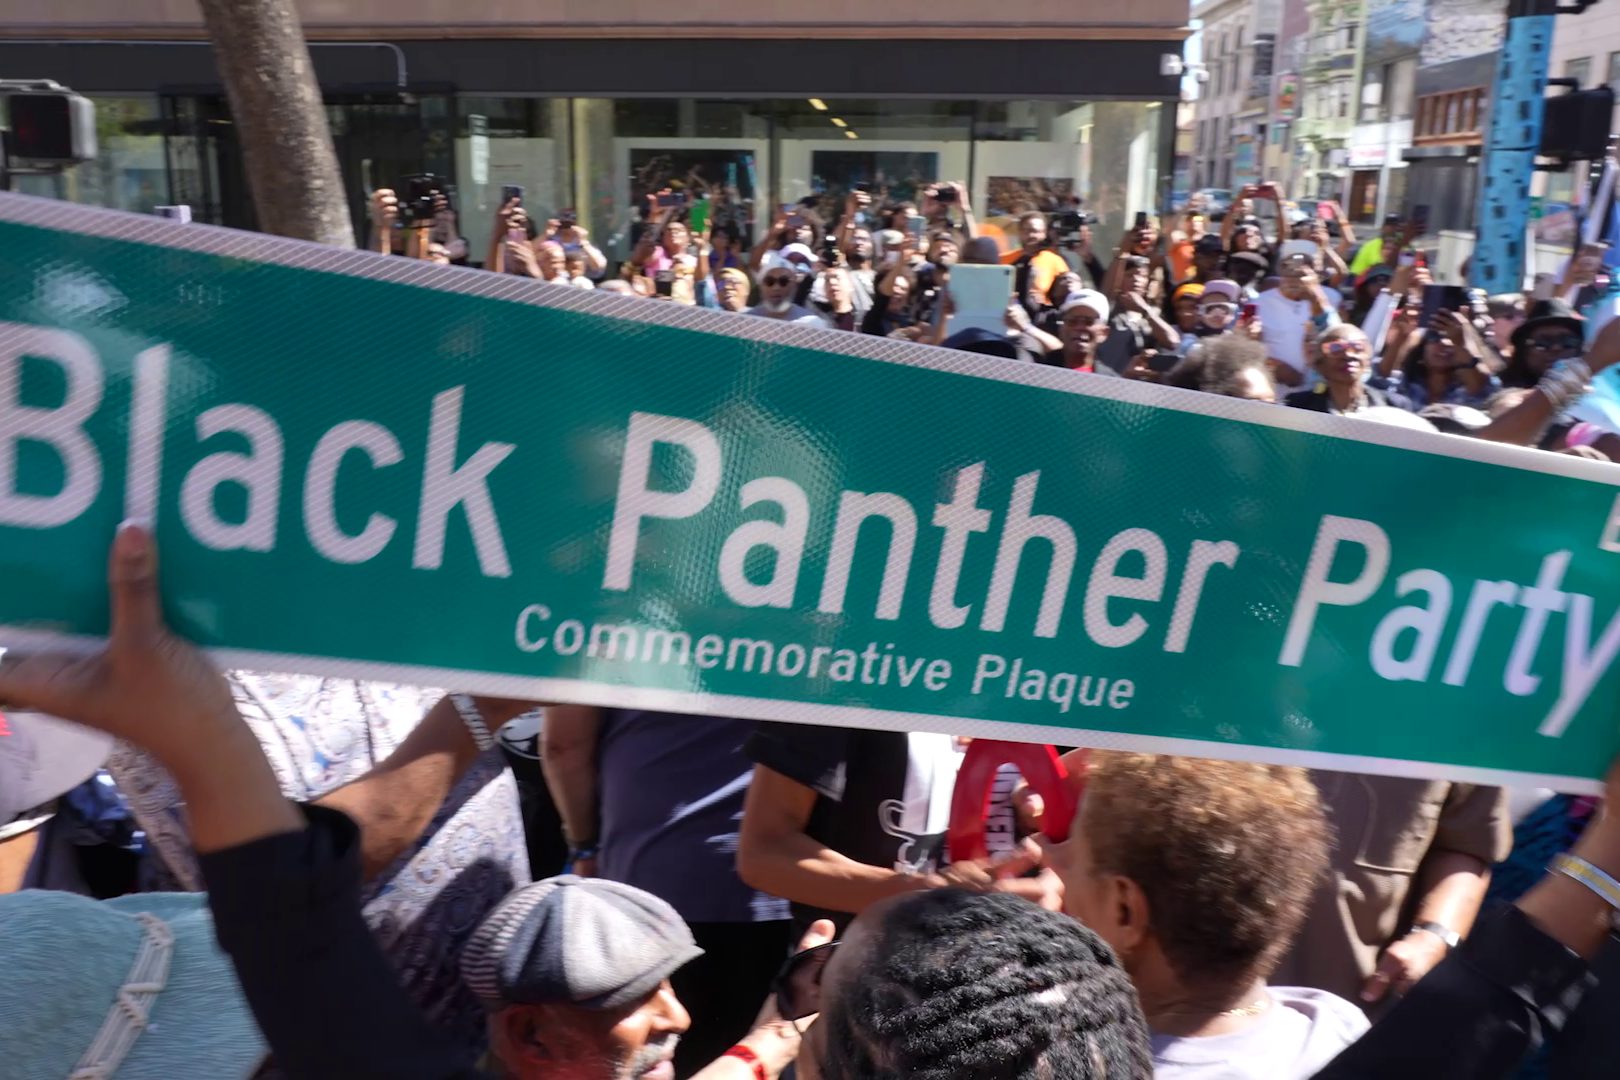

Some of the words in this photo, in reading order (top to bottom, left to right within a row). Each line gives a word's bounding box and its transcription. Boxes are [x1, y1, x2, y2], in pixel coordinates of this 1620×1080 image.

[0, 321, 517, 578] Black
[602, 411, 1240, 653] Panther
[1279, 514, 1620, 738] Party
[515, 604, 951, 691] Commemorative
[971, 654, 1135, 713] Plaque
